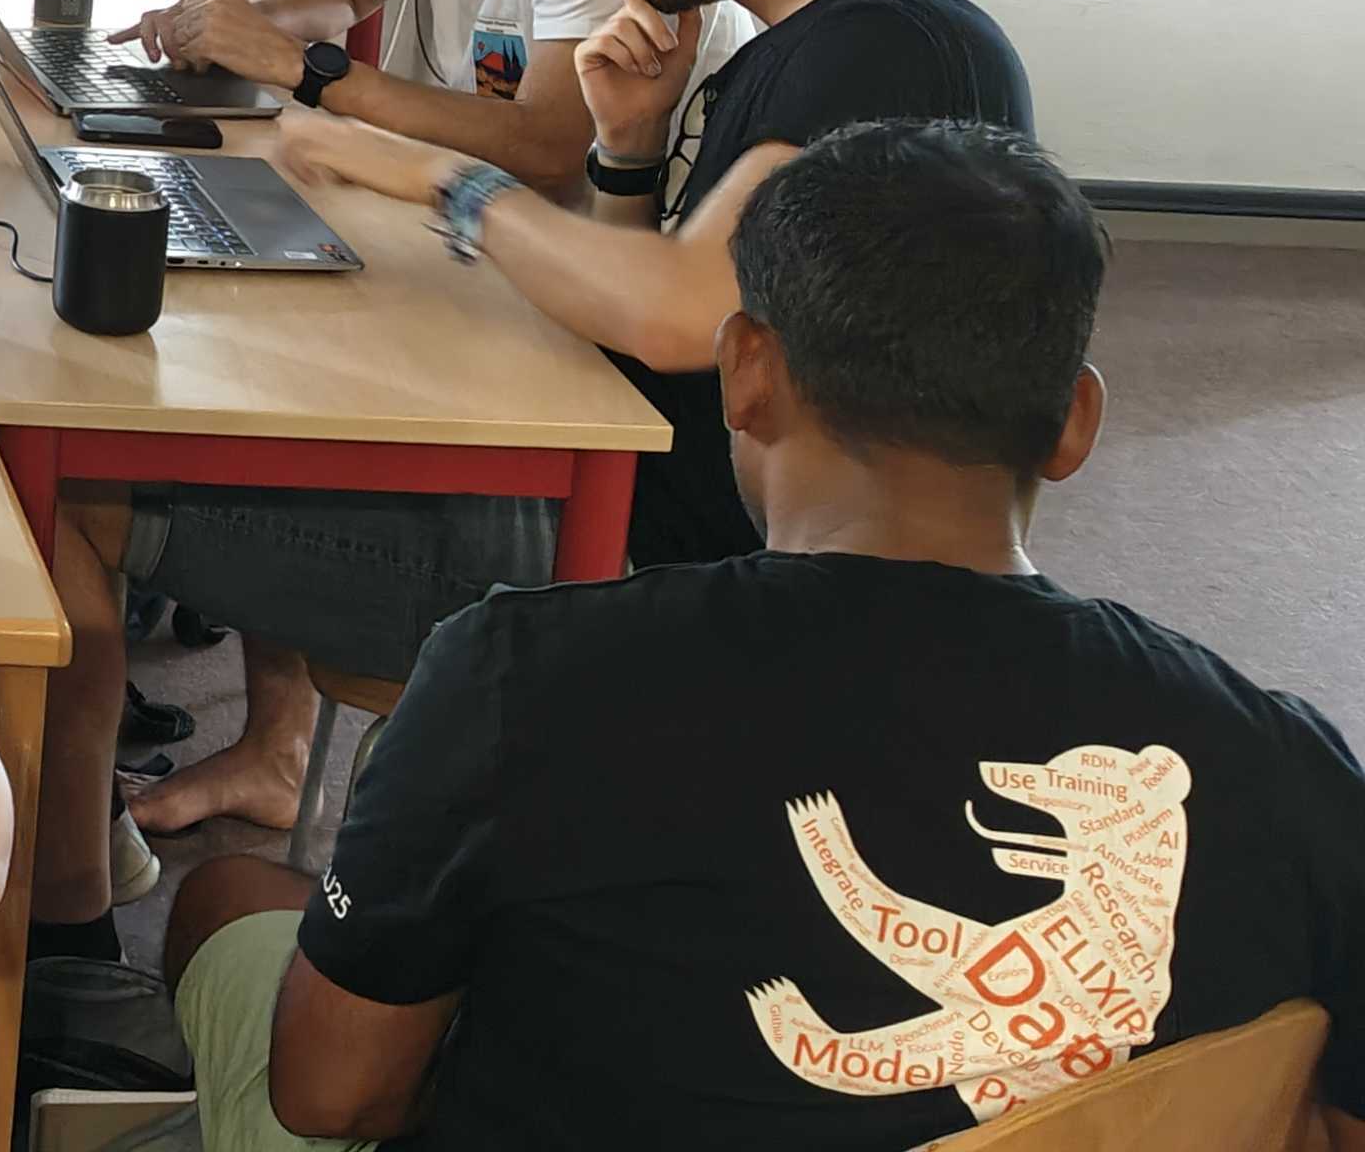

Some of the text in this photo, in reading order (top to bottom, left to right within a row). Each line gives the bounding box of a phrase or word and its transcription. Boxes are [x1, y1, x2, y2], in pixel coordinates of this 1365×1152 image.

[1080, 752, 1117, 771] RDM
[989, 767, 1129, 803] Use Training
[1079, 799, 1145, 836] Standard
[1123, 807, 1173, 848] Platform
[1156, 831, 1179, 850] AI
[801, 817, 865, 912] Integrate
[1008, 852, 1070, 876] Service
[1094, 842, 1164, 894] Annotate
[871, 903, 963, 960] Tool
[1080, 861, 1157, 984] Research
[1041, 914, 1147, 1036] ELIXIR
[849, 1036, 887, 1054] LLM
[893, 1010, 964, 1046] Benchmark
[792, 1032, 946, 1087] Model
